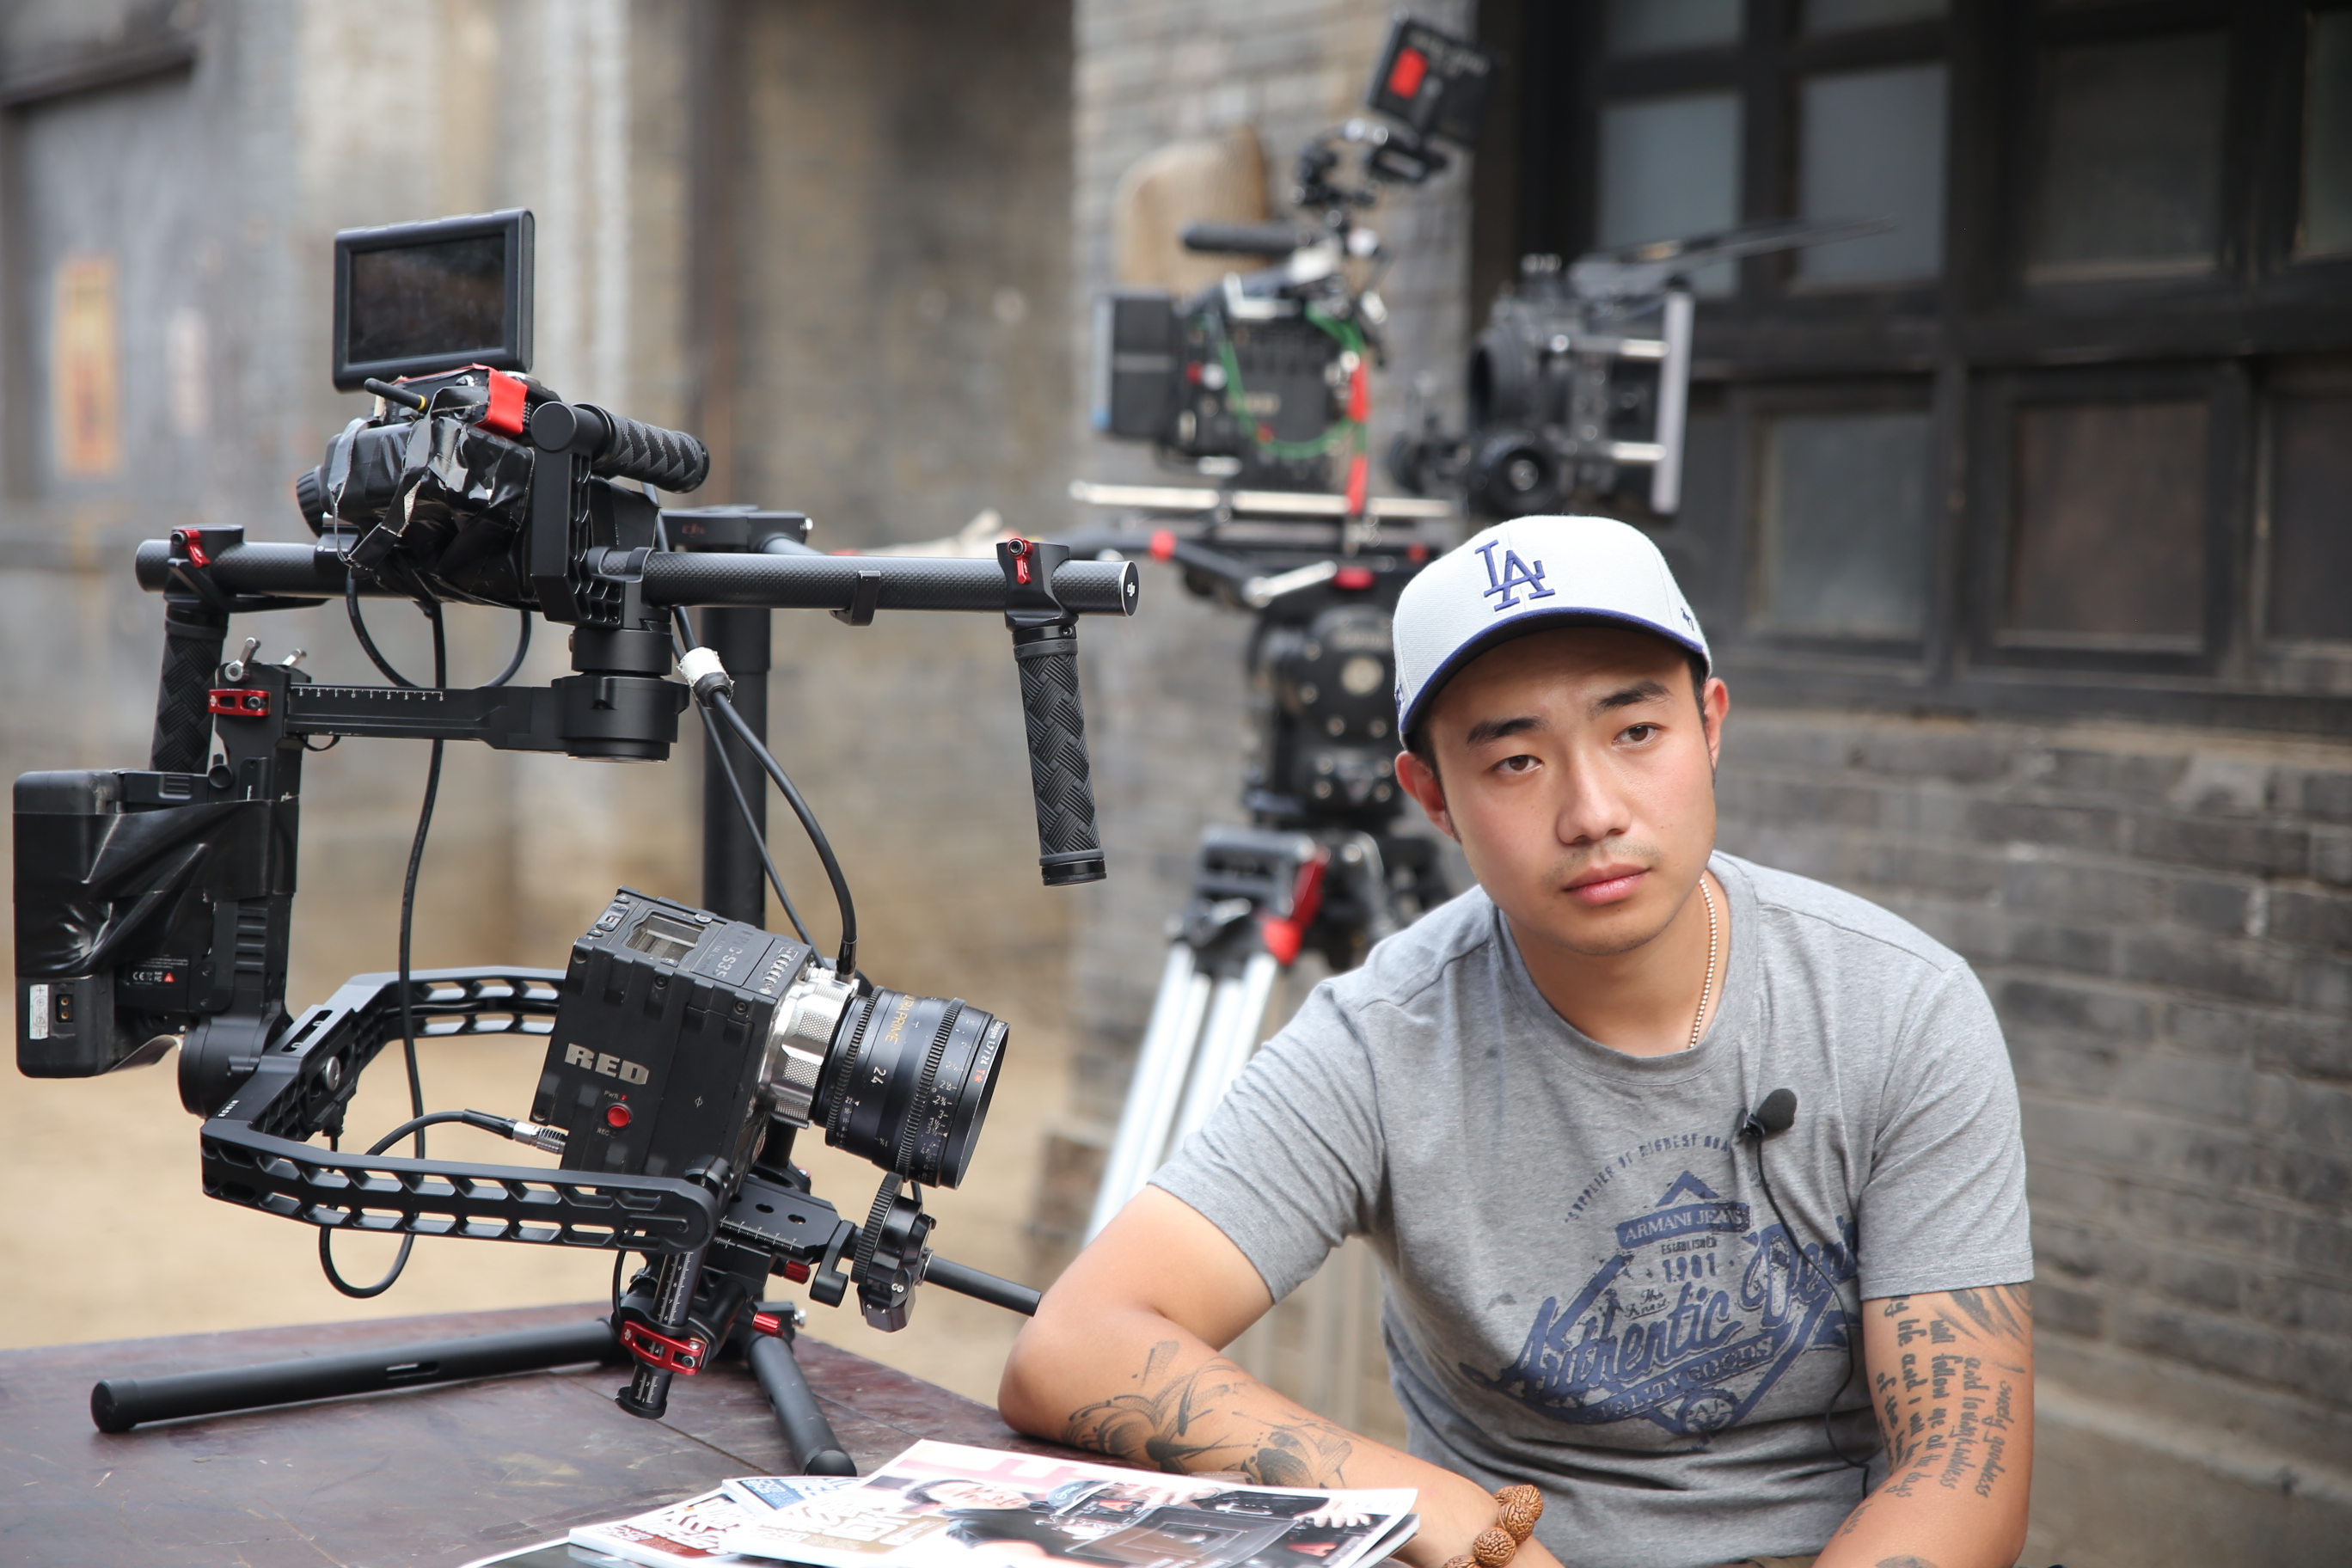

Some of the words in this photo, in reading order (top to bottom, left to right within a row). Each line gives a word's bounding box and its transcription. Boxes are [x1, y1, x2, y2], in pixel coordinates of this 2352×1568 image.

[1474, 539, 1556, 612] LA
[885, 1011, 908, 1045] PRIME
[564, 1043, 650, 1086] RED
[870, 1066, 887, 1085] 24
[603, 1090, 619, 1100] PWR
[597, 1127, 610, 1136] REC
[1624, 1210, 1692, 1243] ARMANI
[1696, 1209, 1743, 1225] JEANS
[1662, 1253, 1716, 1283] 1981
[1897, 1318, 1927, 1347] life
[1930, 1319, 1956, 1344] will
[1687, 1335, 1773, 1382] GOODS
[1901, 1353, 1928, 1392] and
[1932, 1352, 1963, 1399] follow
